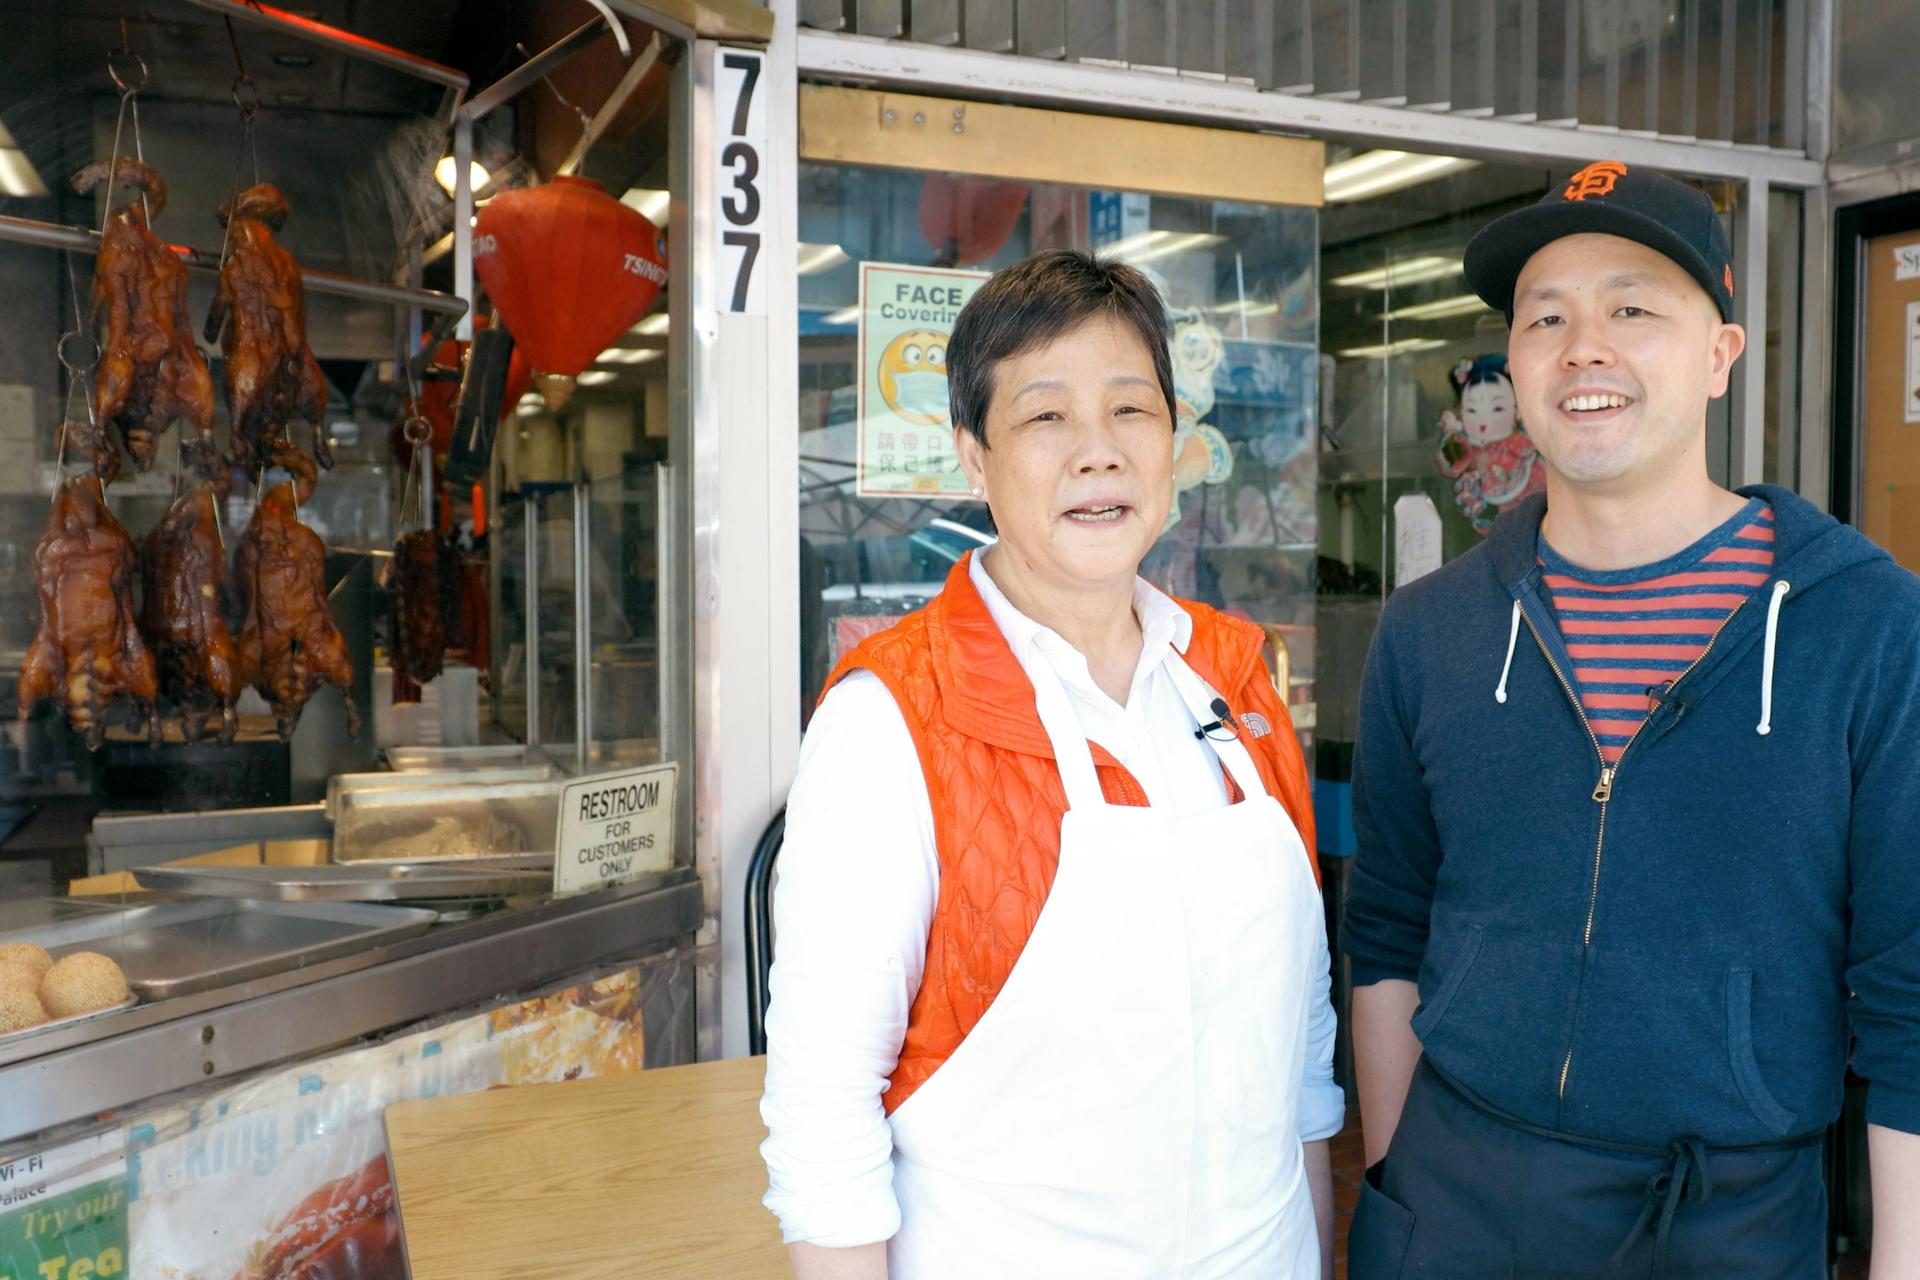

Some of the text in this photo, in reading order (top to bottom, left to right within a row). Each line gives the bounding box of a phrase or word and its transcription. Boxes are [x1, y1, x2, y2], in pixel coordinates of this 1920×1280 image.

[722, 53, 761, 313] 737
[896, 283, 963, 307] FACE
[877, 432, 957, 452] 請帶口
[579, 780, 660, 822] RESTROOM
[605, 820, 632, 840] FOR
[577, 833, 656, 864] CUSTOMERS
[600, 856, 633, 878] ONLY
[29, 1154, 43, 1173] Fi
[127, 1101, 278, 1203] Pking
[0, 1183, 47, 1207] alace
[22, 1190, 123, 1240] Try our
[38, 1247, 122, 1280] Tea
